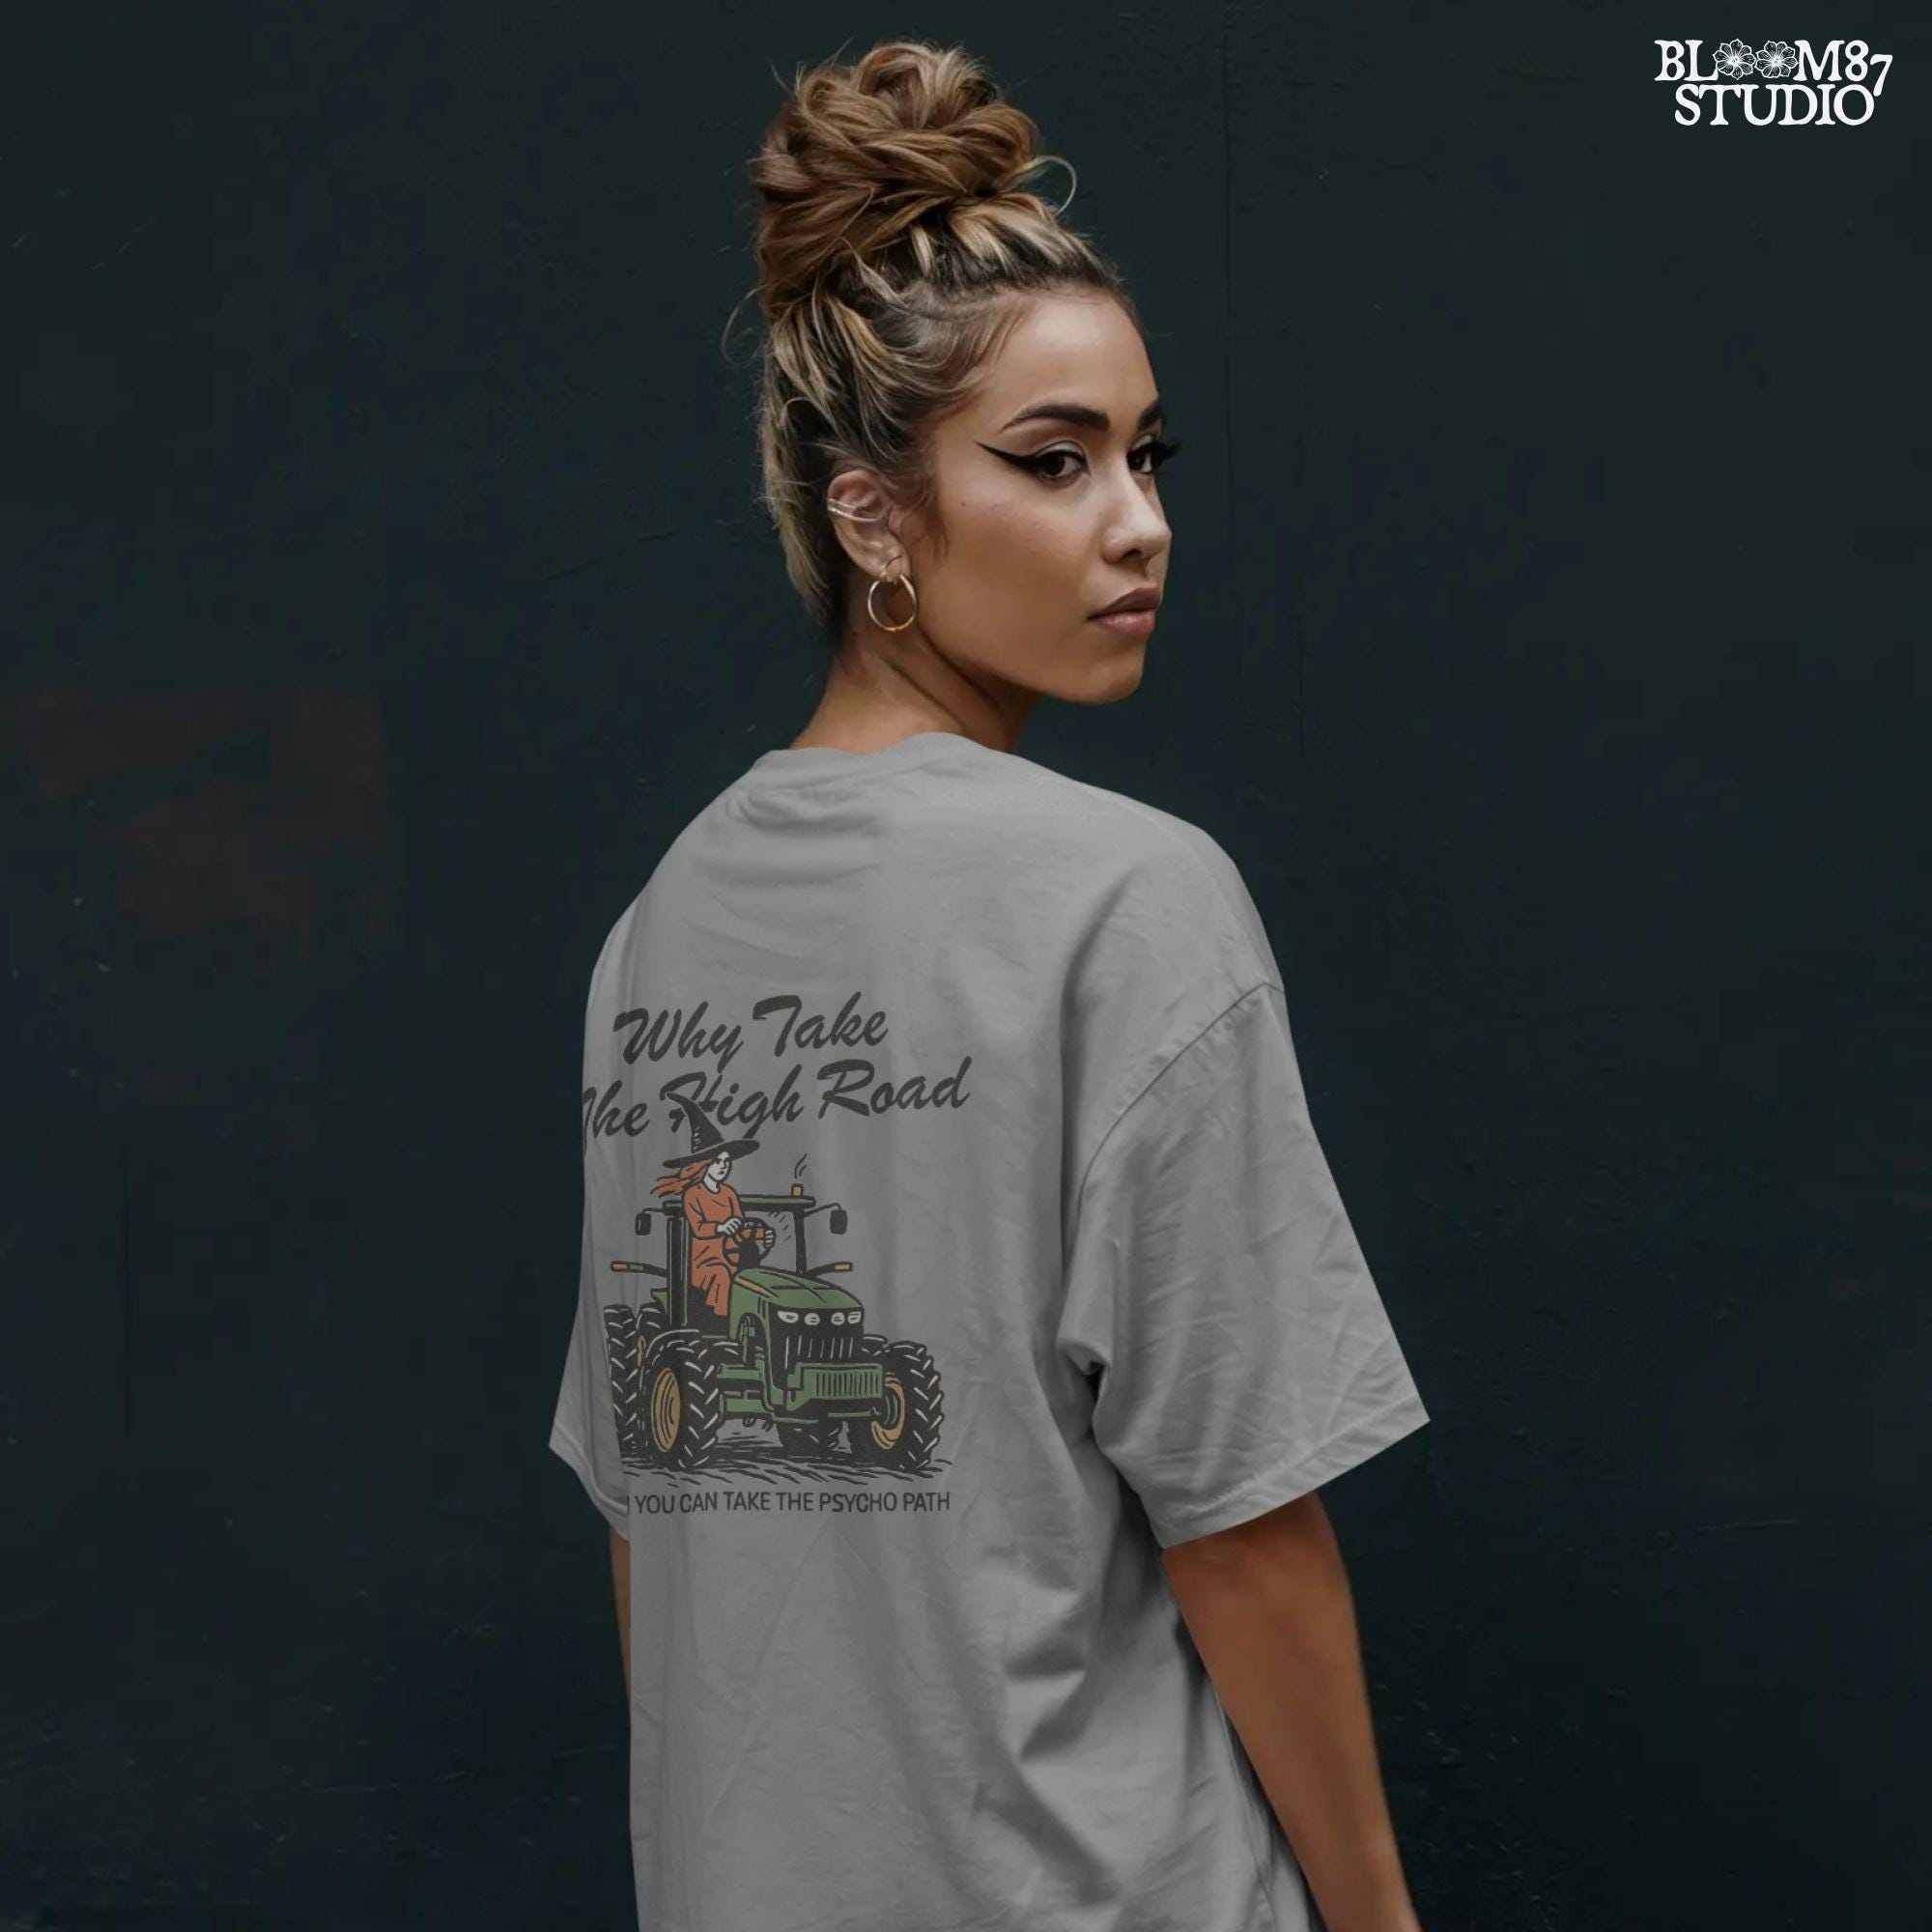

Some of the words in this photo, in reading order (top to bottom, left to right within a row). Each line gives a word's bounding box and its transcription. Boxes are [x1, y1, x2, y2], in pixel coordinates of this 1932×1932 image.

[613, 1001, 744, 1074] Why
[753, 991, 889, 1058] Take
[817, 1056, 973, 1120] Road
[634, 1493, 675, 1515] YOU
[679, 1492, 718, 1514] CAN
[724, 1492, 771, 1512] TAKE
[776, 1492, 813, 1512] THE
[820, 1492, 898, 1514] PSYCHO
[902, 1491, 951, 1512] PATH
